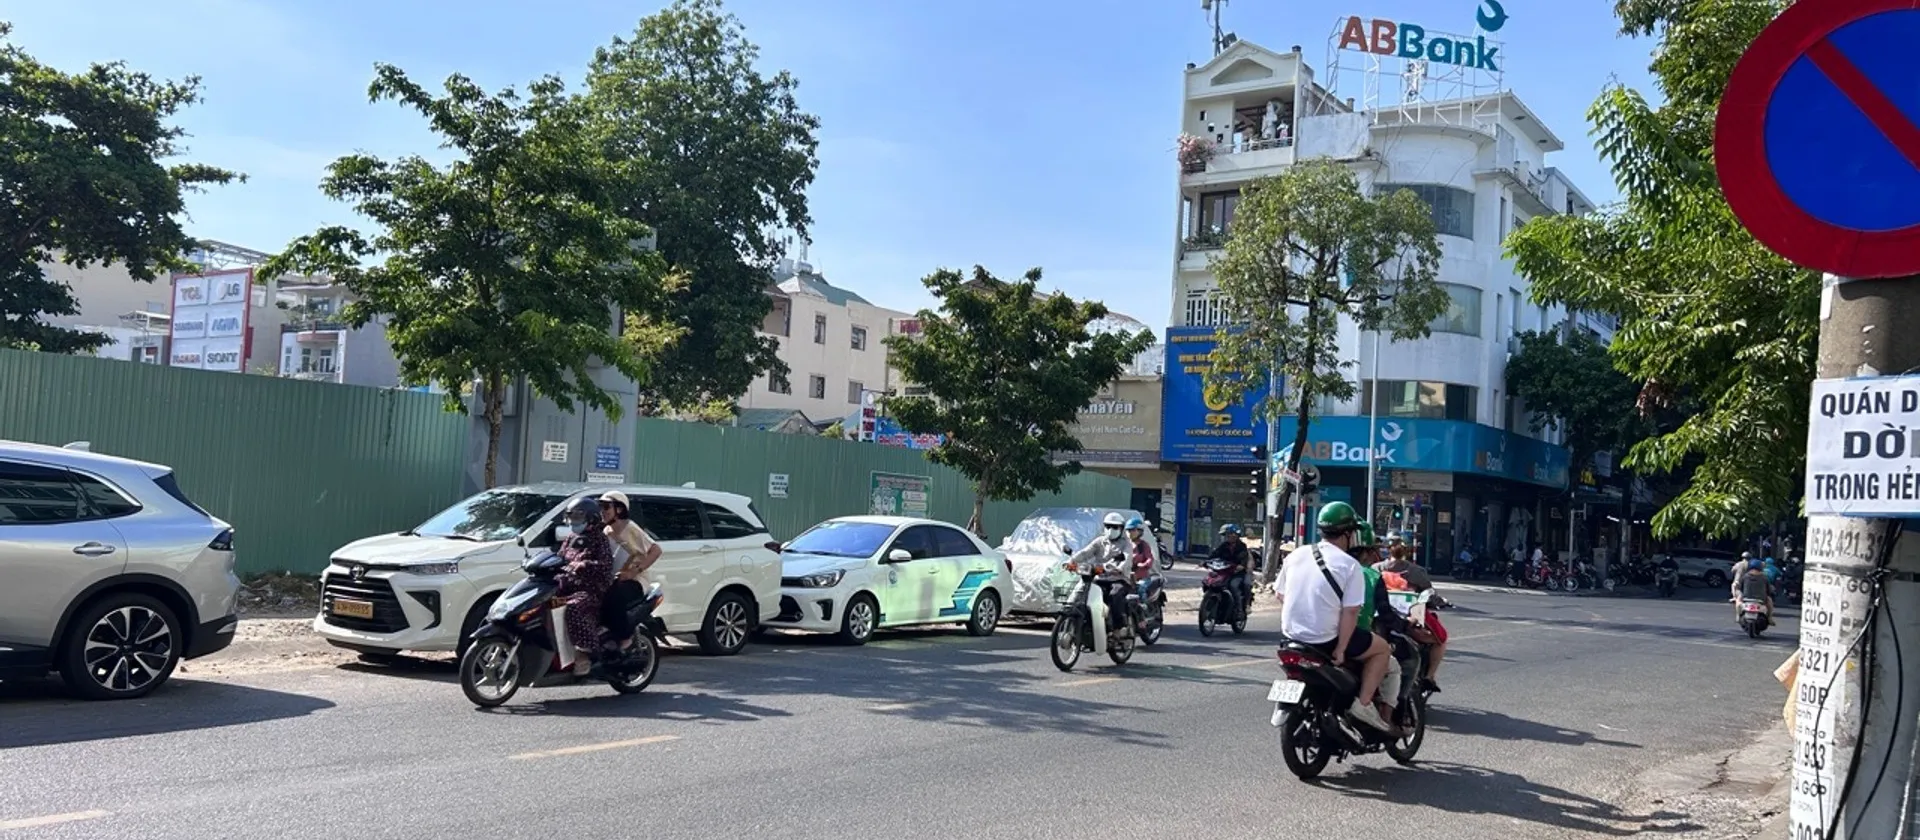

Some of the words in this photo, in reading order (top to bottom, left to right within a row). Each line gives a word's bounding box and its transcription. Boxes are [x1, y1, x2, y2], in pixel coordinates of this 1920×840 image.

[1338, 15, 1499, 71] ABBank
[226, 282, 240, 296] LG
[207, 352, 238, 364] SONY
[1820, 385, 1891, 419] QUÁN
[1901, 389, 1919, 413] D
[1813, 472, 1880, 501] TRONG
